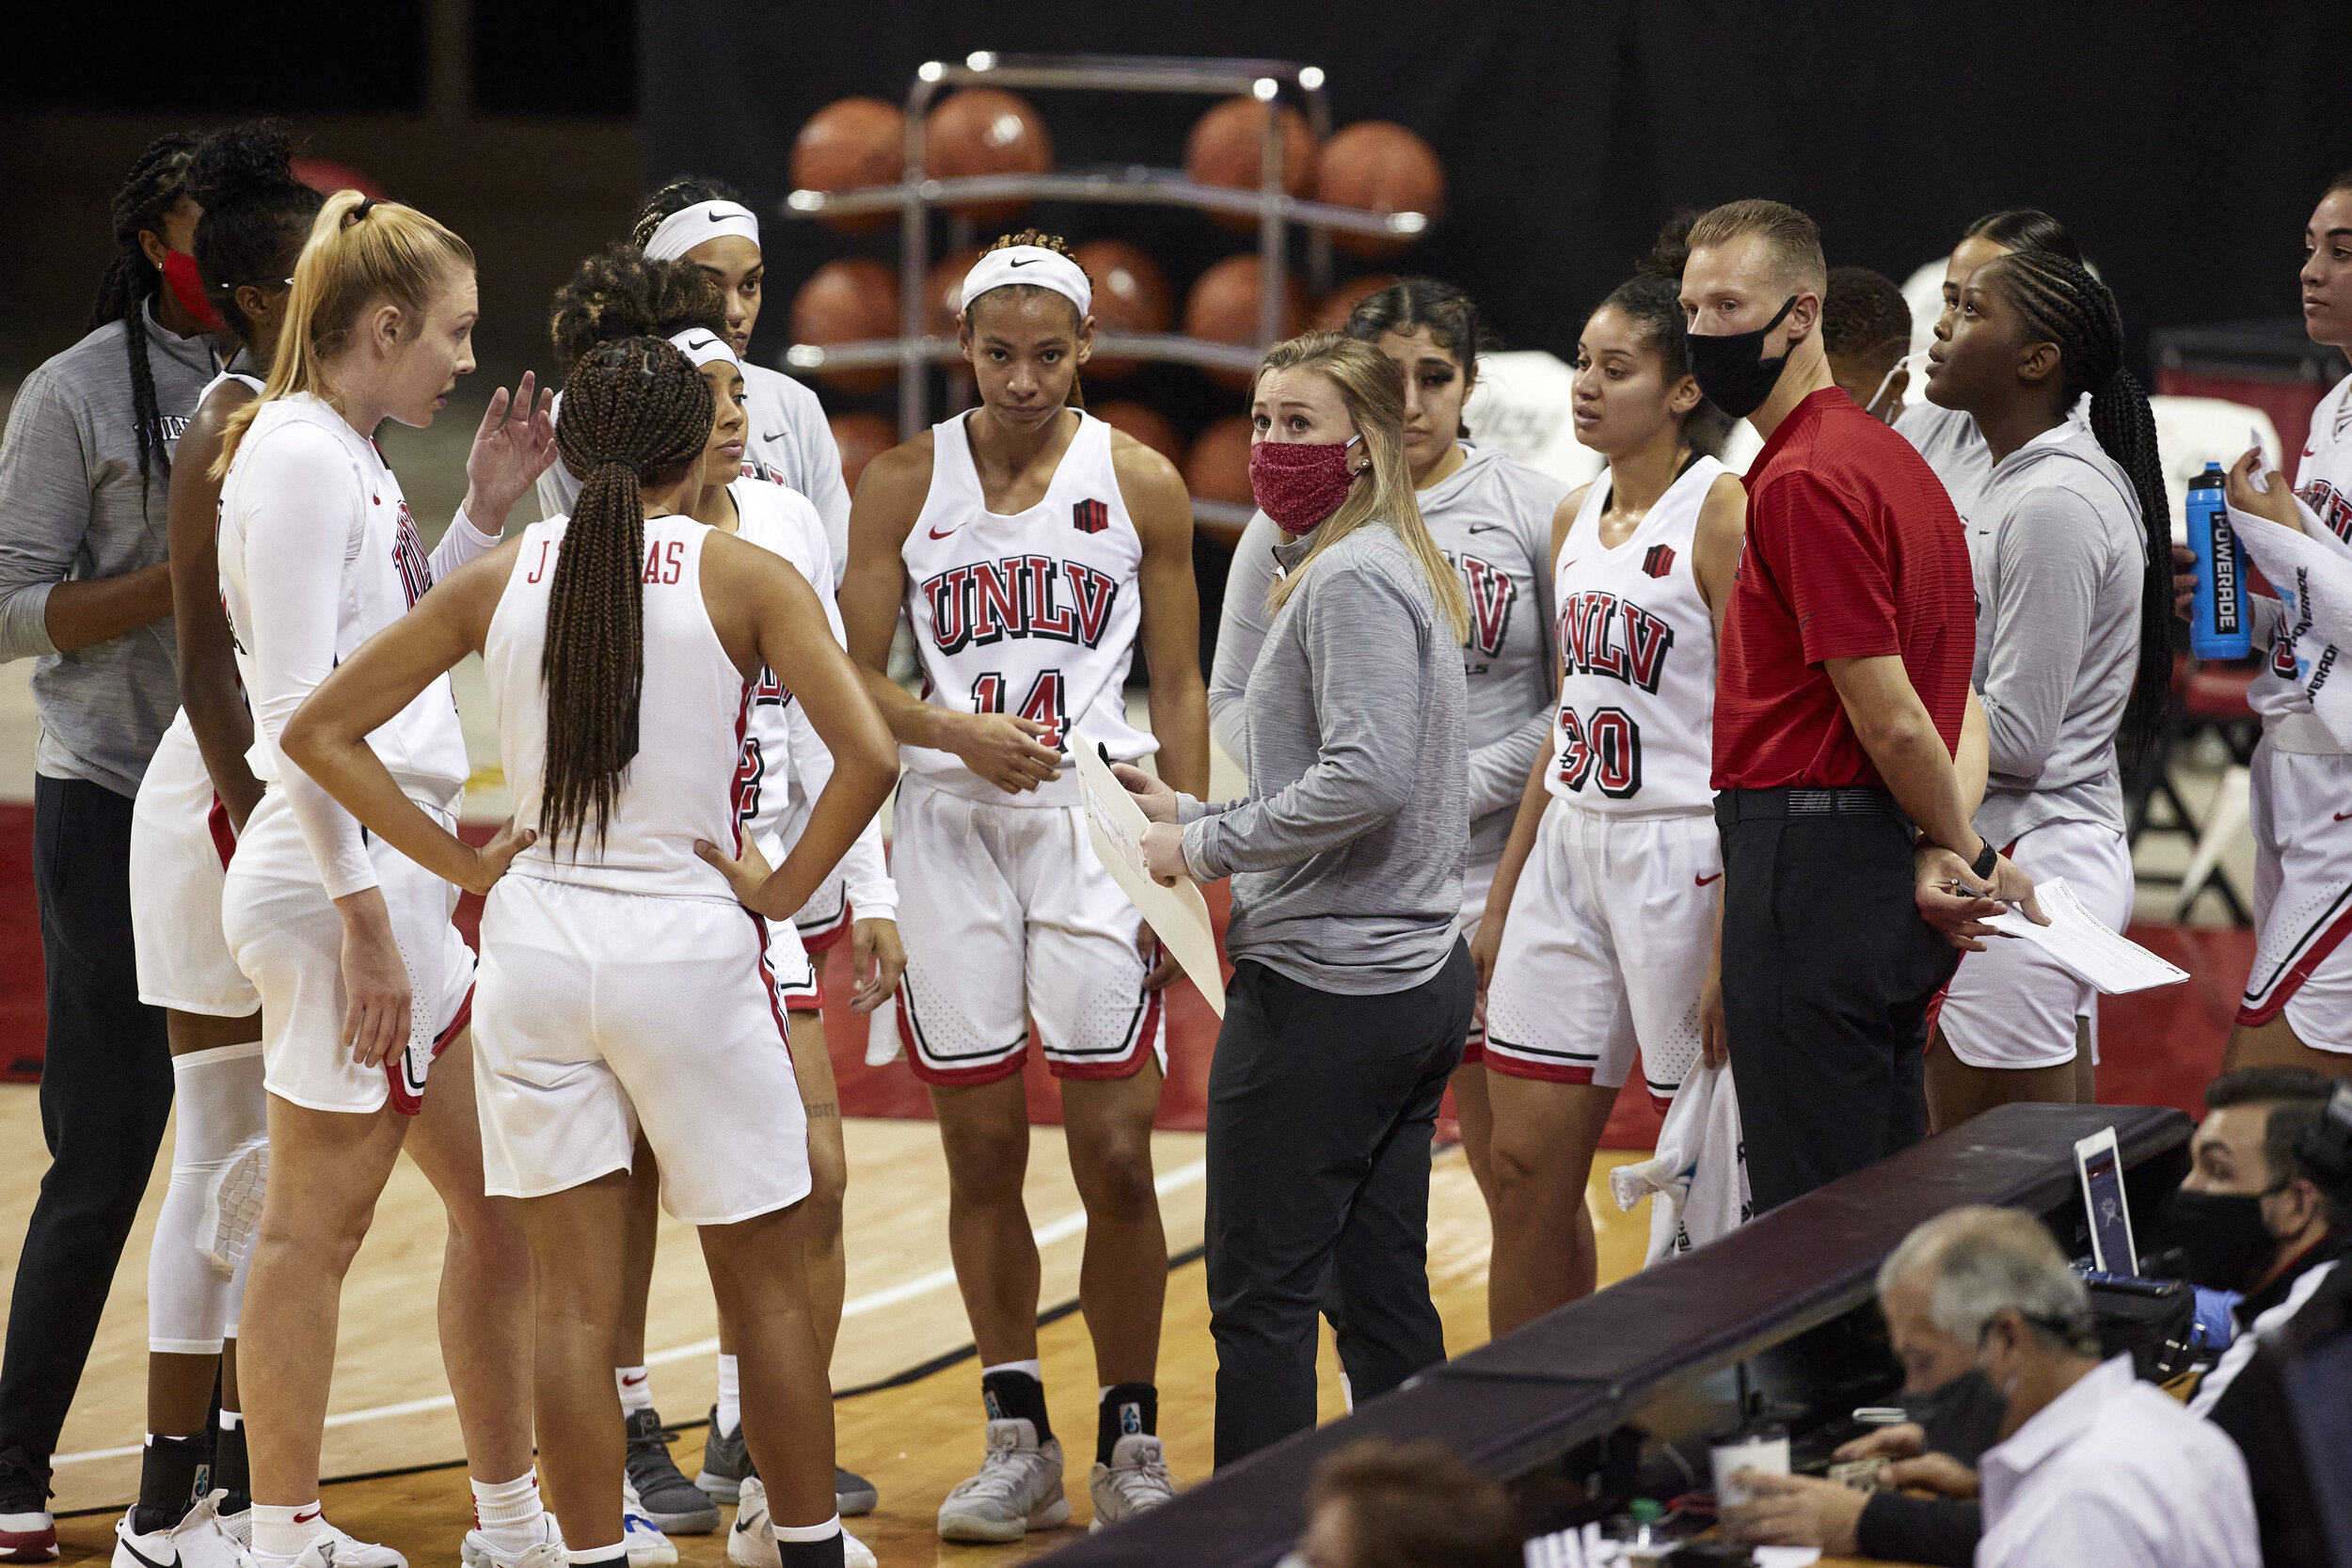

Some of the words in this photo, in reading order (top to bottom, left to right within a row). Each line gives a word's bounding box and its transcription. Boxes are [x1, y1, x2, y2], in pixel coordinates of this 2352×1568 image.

[921, 554, 1119, 657] UNLV
[2214, 514, 2236, 629] POWERADE
[1554, 590, 1674, 695] NLV
[971, 669, 1071, 753] 14
[1558, 706, 1642, 800] 30
